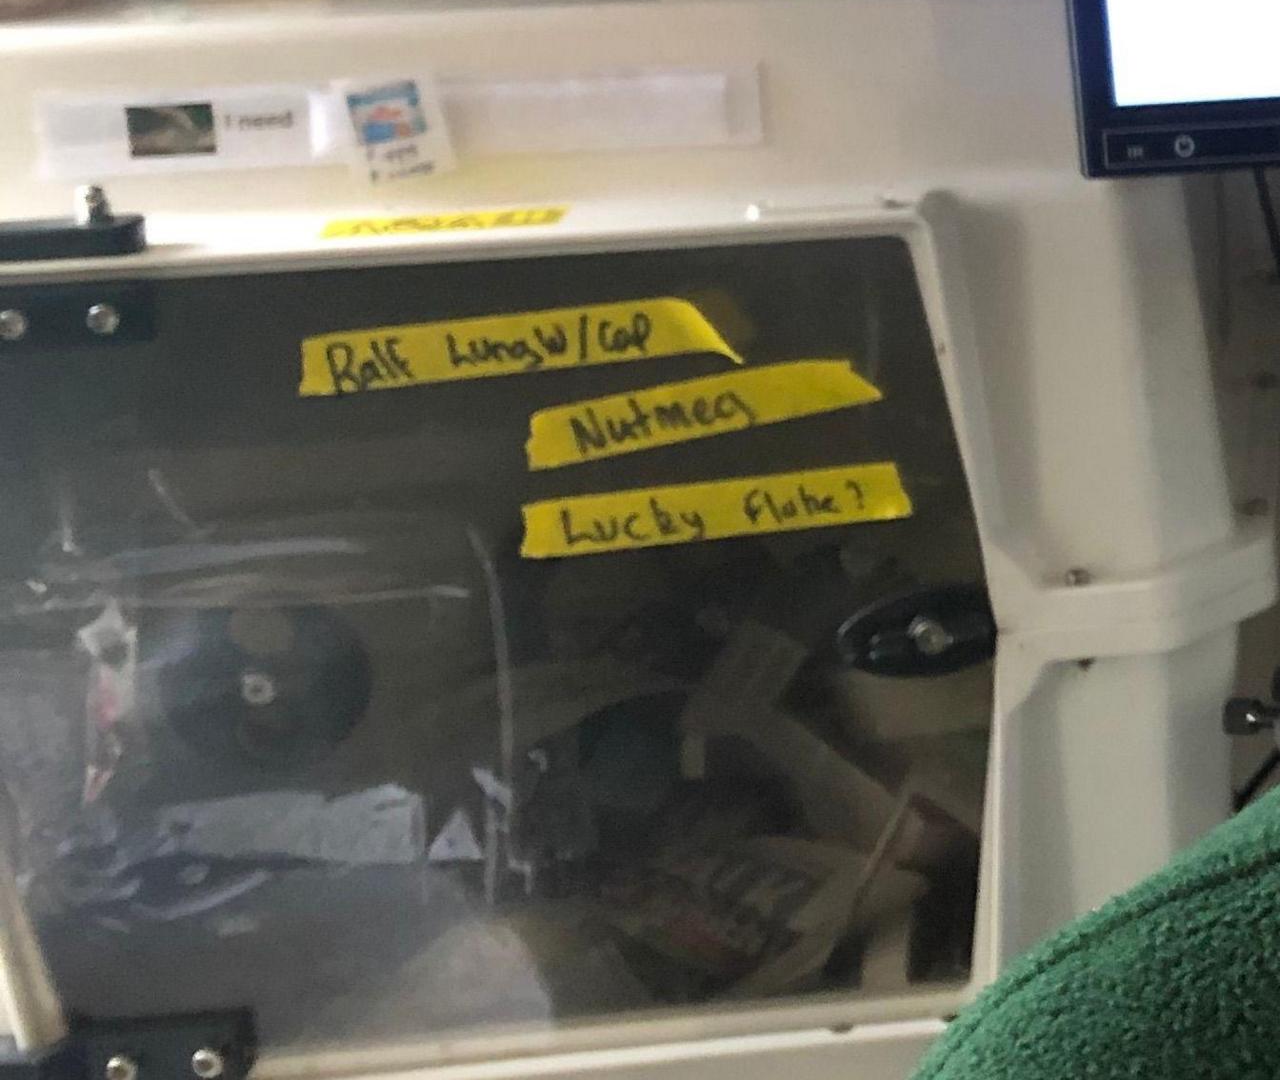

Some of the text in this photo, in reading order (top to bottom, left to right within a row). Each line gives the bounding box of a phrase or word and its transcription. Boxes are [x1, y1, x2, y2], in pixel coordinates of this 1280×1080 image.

[325, 336, 413, 396] Ralf
[570, 390, 757, 457] Nutmeg
[560, 496, 707, 546] Lucky
